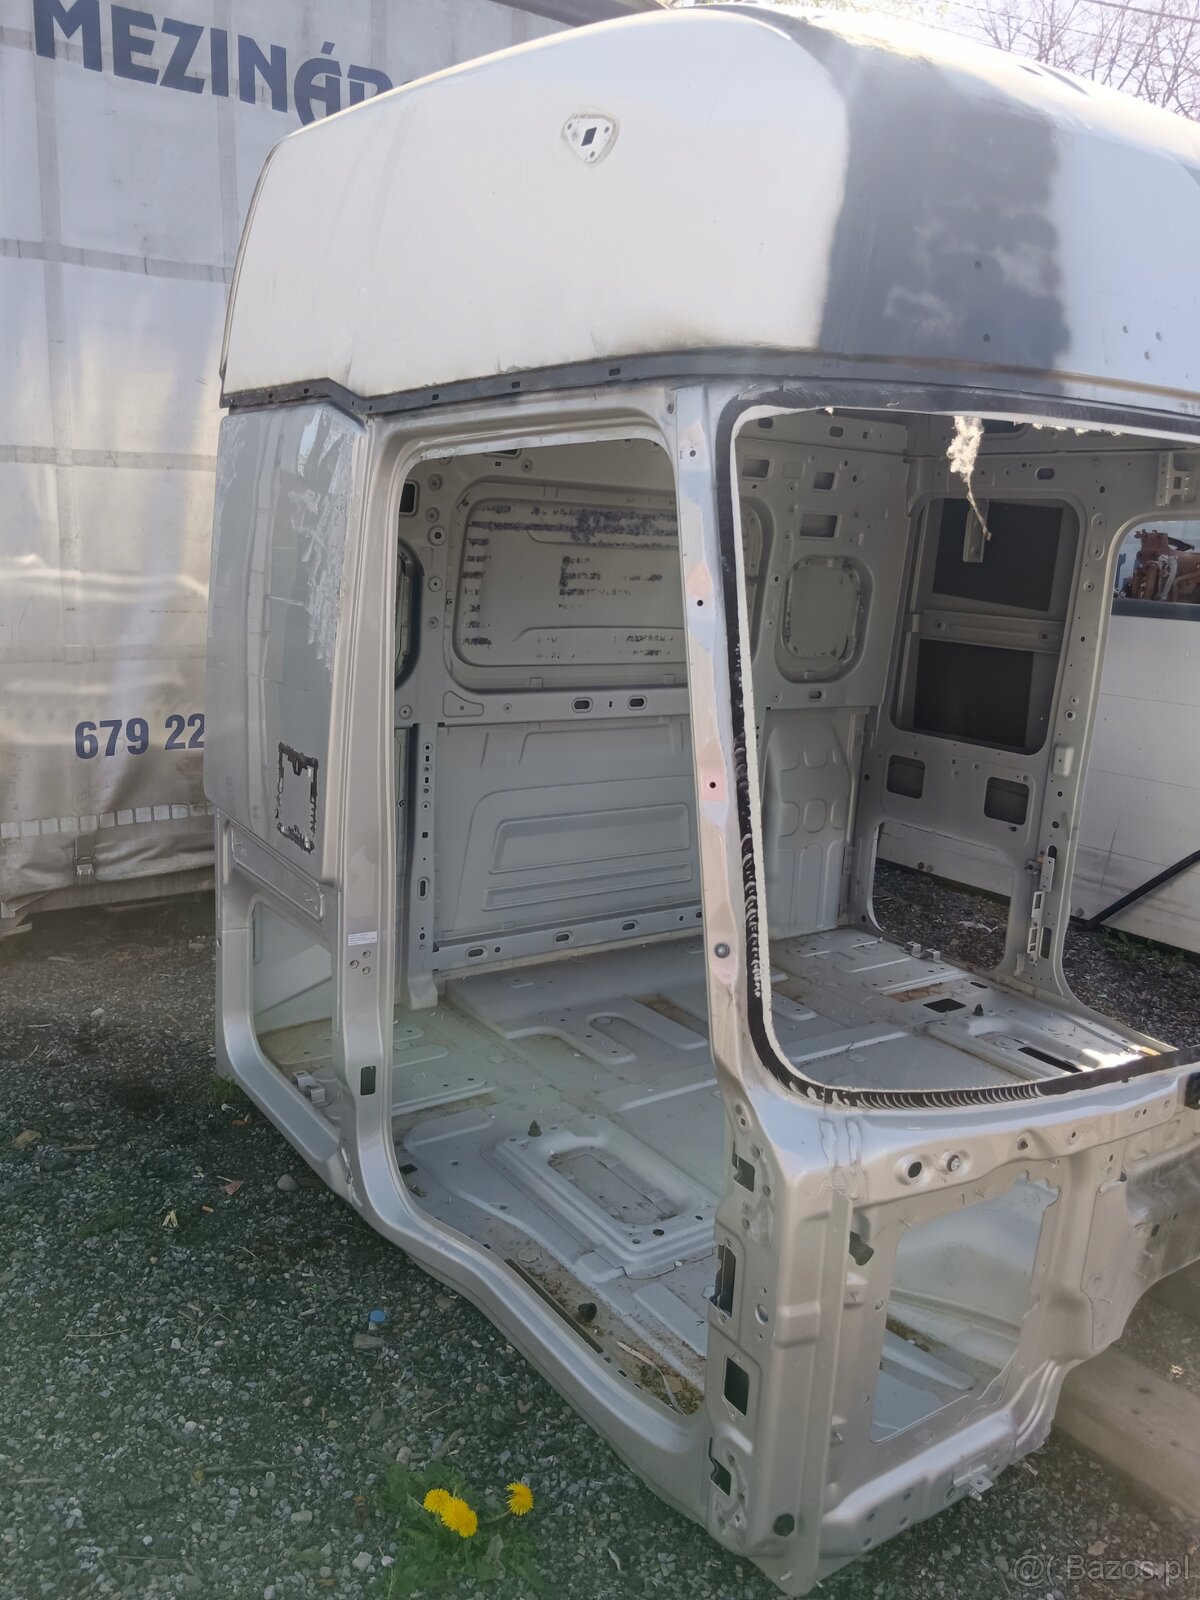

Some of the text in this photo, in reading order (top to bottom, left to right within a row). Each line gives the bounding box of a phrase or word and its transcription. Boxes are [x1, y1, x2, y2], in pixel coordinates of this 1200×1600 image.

[33, 0, 413, 126] MEZINÁ
[75, 713, 205, 759] 679 22
